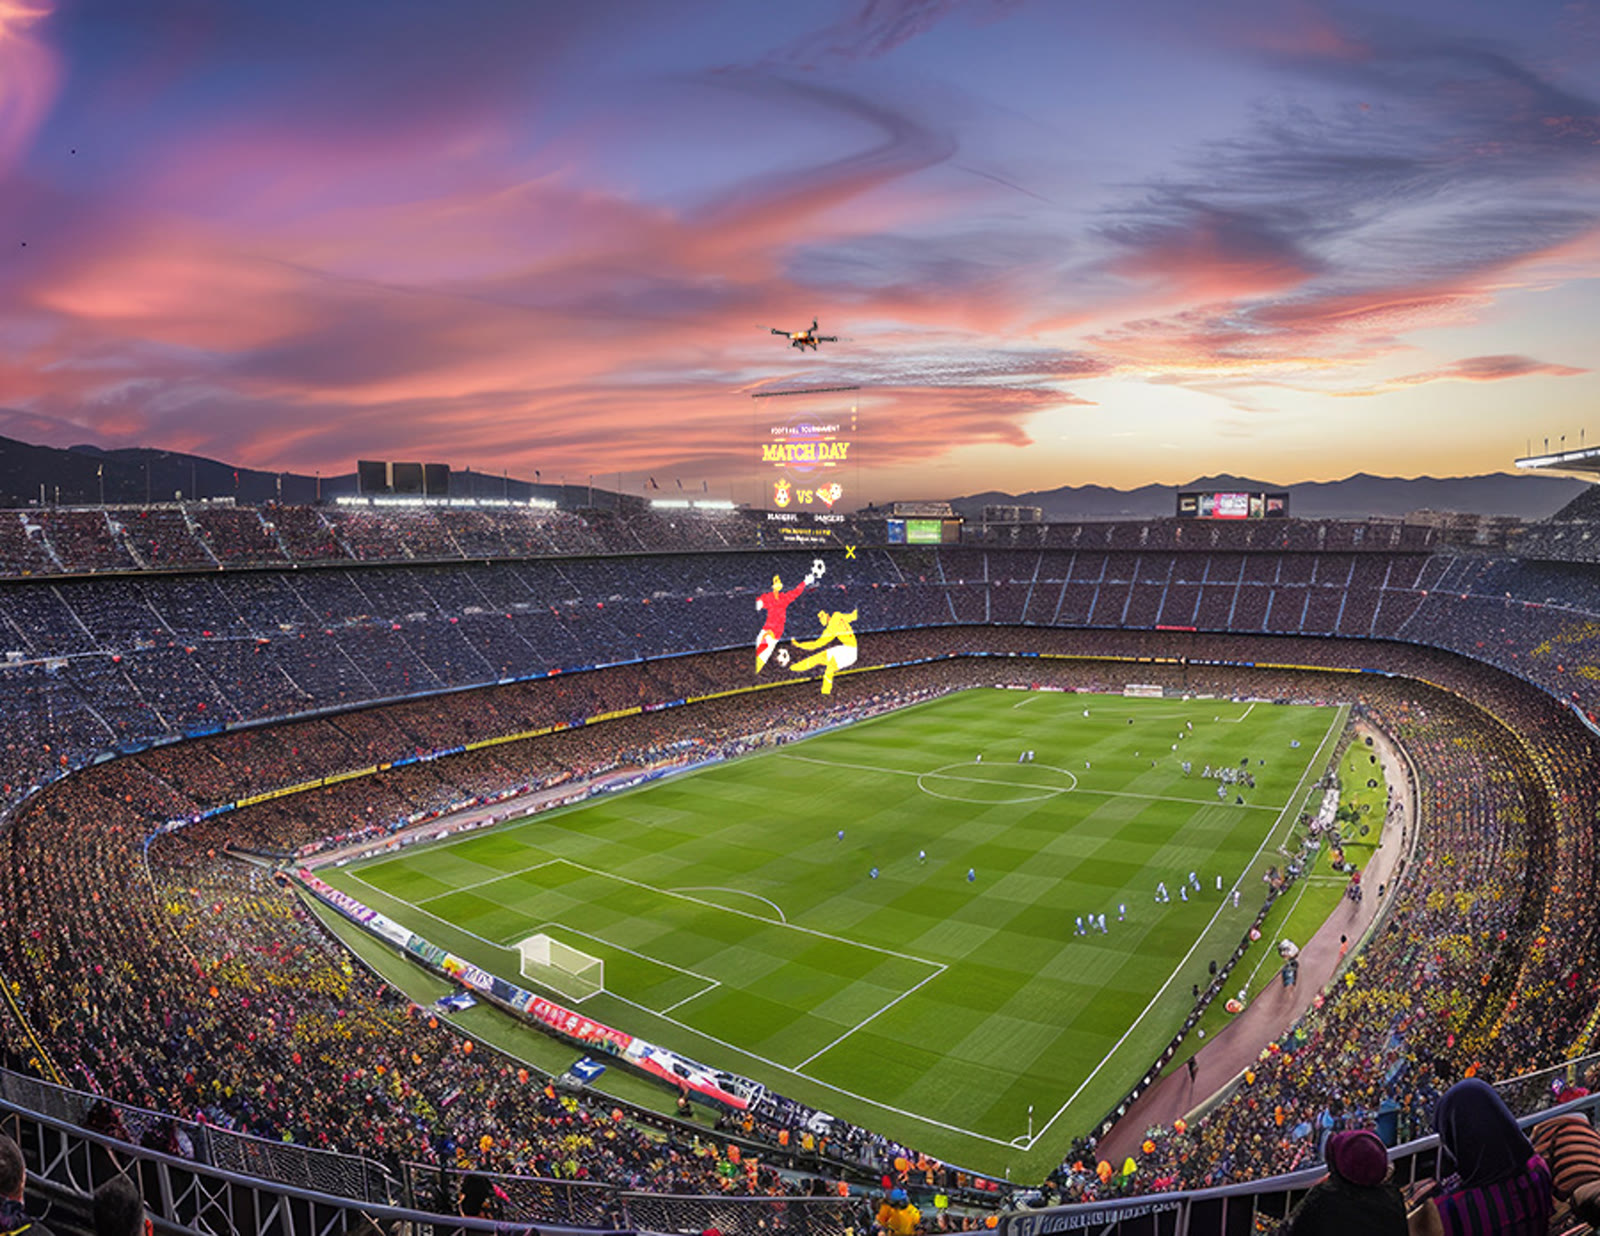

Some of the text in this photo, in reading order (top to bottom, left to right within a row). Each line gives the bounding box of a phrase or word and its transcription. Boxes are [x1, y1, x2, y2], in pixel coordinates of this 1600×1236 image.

[762, 442, 850, 461] MATCH DAY
[796, 490, 813, 504] VS
